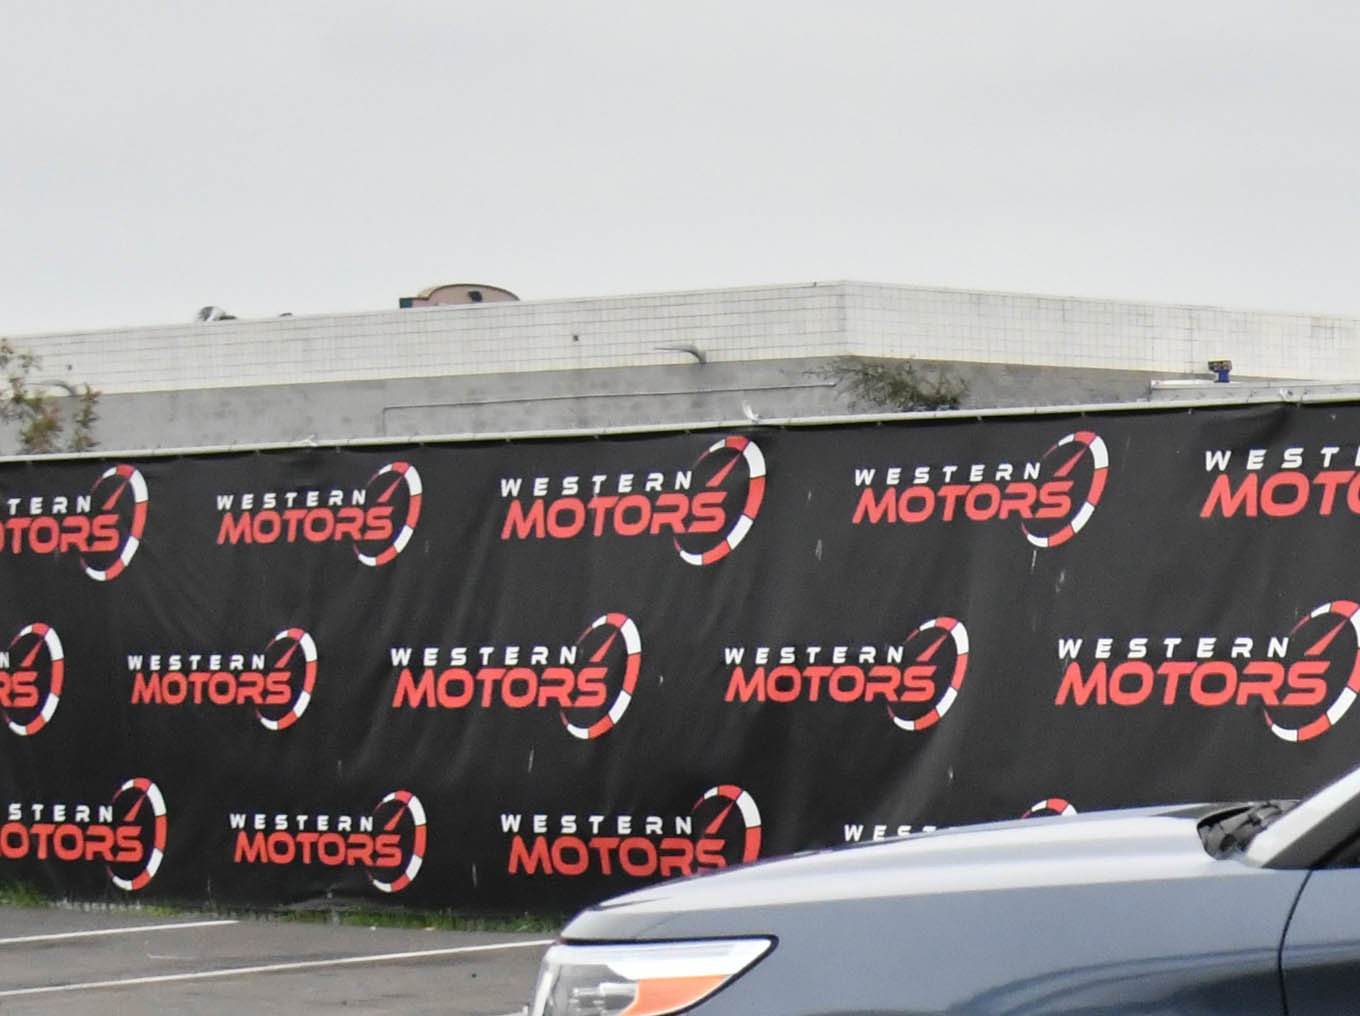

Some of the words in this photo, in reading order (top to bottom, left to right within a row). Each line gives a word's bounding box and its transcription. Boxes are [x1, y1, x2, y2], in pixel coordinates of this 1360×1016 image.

[500, 470, 693, 499] WESTERN
[854, 461, 1041, 487] WESTERN
[7, 495, 91, 516] TERN
[216, 489, 366, 511] WESTERN
[501, 490, 728, 540] MOTORS
[851, 479, 1075, 525] MOTORS
[0, 513, 121, 555] TORS
[217, 505, 394, 545] MOTORS
[127, 654, 265, 671] WESTERN
[390, 645, 577, 667] WESTERN
[724, 645, 904, 665] WESTERN
[1058, 636, 1290, 660] WESTERN
[130, 670, 292, 705] MOTORS
[391, 666, 609, 709] MOTORS
[724, 664, 937, 703] MOTORS
[1055, 659, 1331, 708] MOTORS
[8, 803, 113, 823] STERN
[229, 813, 373, 832] WESTERN
[500, 813, 692, 835] WESTERN
[0, 821, 144, 863] OTORS
[234, 830, 403, 868] MOTORS
[508, 835, 727, 876] MOTORS
